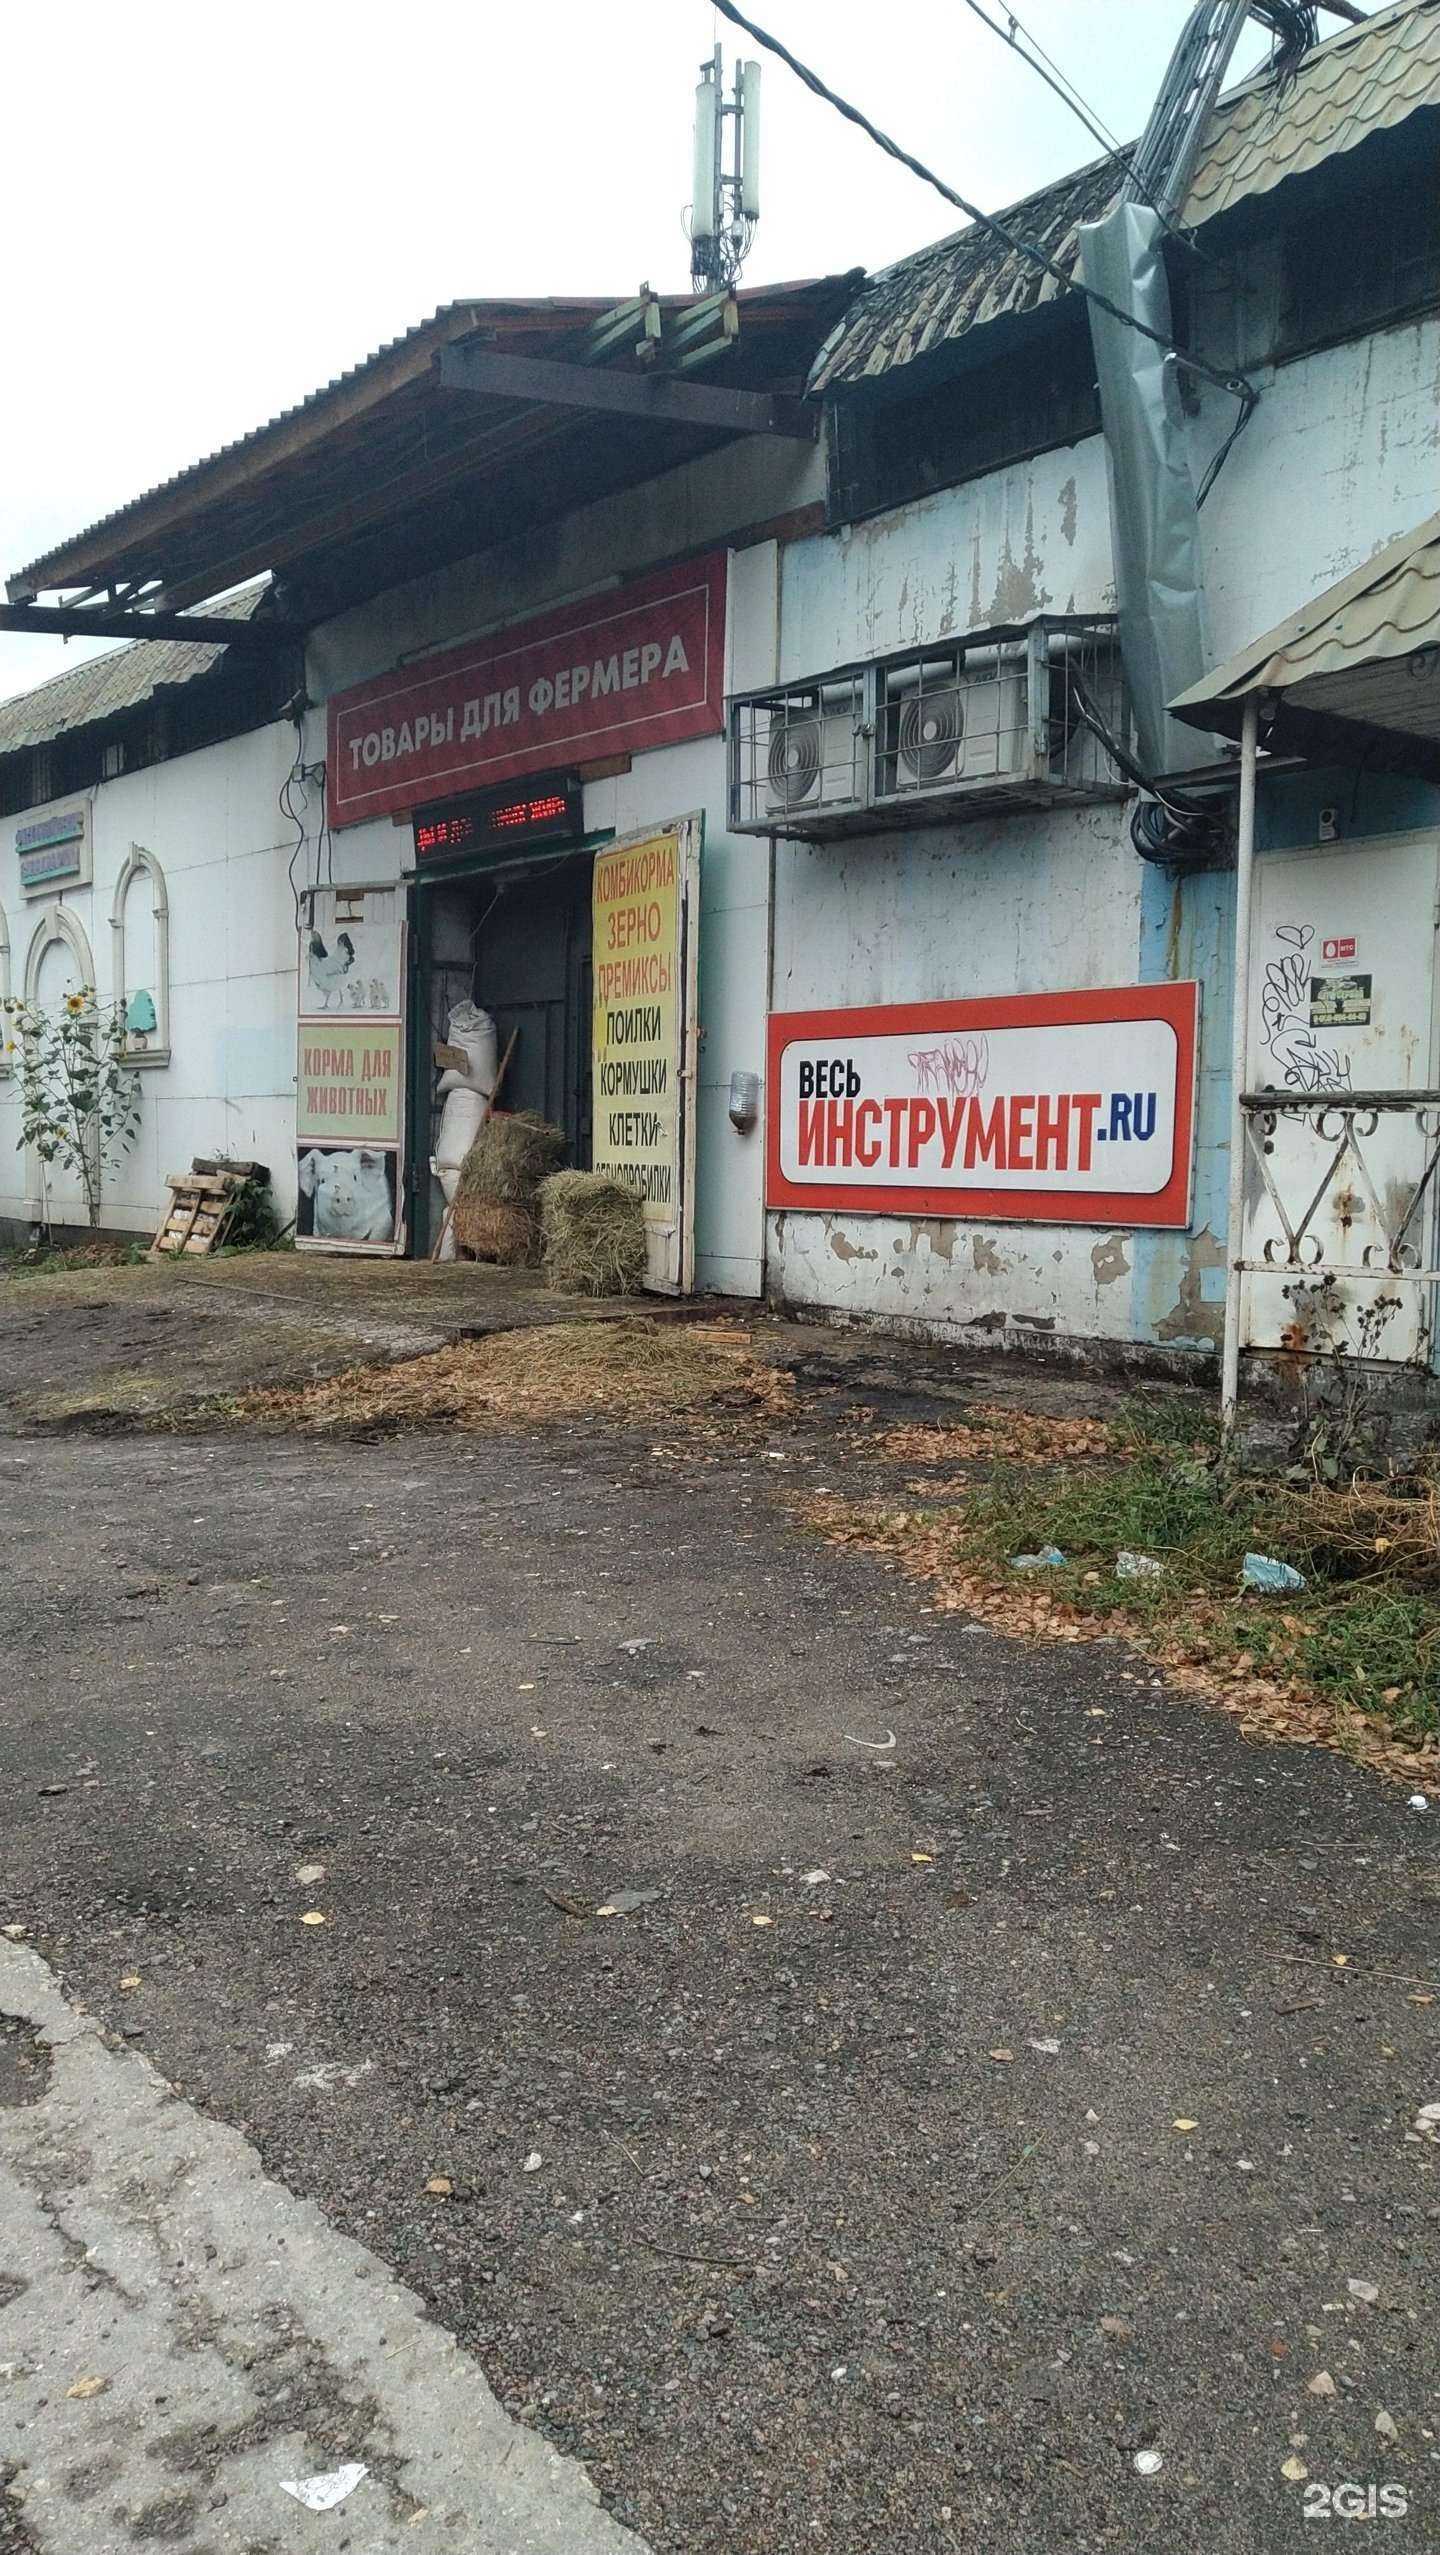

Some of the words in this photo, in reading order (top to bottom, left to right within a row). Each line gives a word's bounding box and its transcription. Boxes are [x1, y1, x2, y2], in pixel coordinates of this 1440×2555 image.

[349, 707, 454, 770] ТОВАРЫ
[460, 687, 520, 743] ДЛЯ
[528, 635, 690, 716] ФЕРМЕРА
[597, 848, 675, 903] КОМБИКОРМА
[607, 901, 661, 950] ЗЕРНО
[599, 952, 671, 1002] ПРЕМИКСЫ
[607, 1005, 661, 1045] ПОИЛКИ
[304, 1048, 354, 1078] КОРМА
[361, 1050, 392, 1082] ДЛЯ
[601, 1059, 667, 1096] КОРМУШКИ
[799, 1059, 861, 1098] ВЕСЬ
[307, 1085, 387, 1116] ЖИВОТНЫХ
[609, 1112, 658, 1147] КЛЕТКИ
